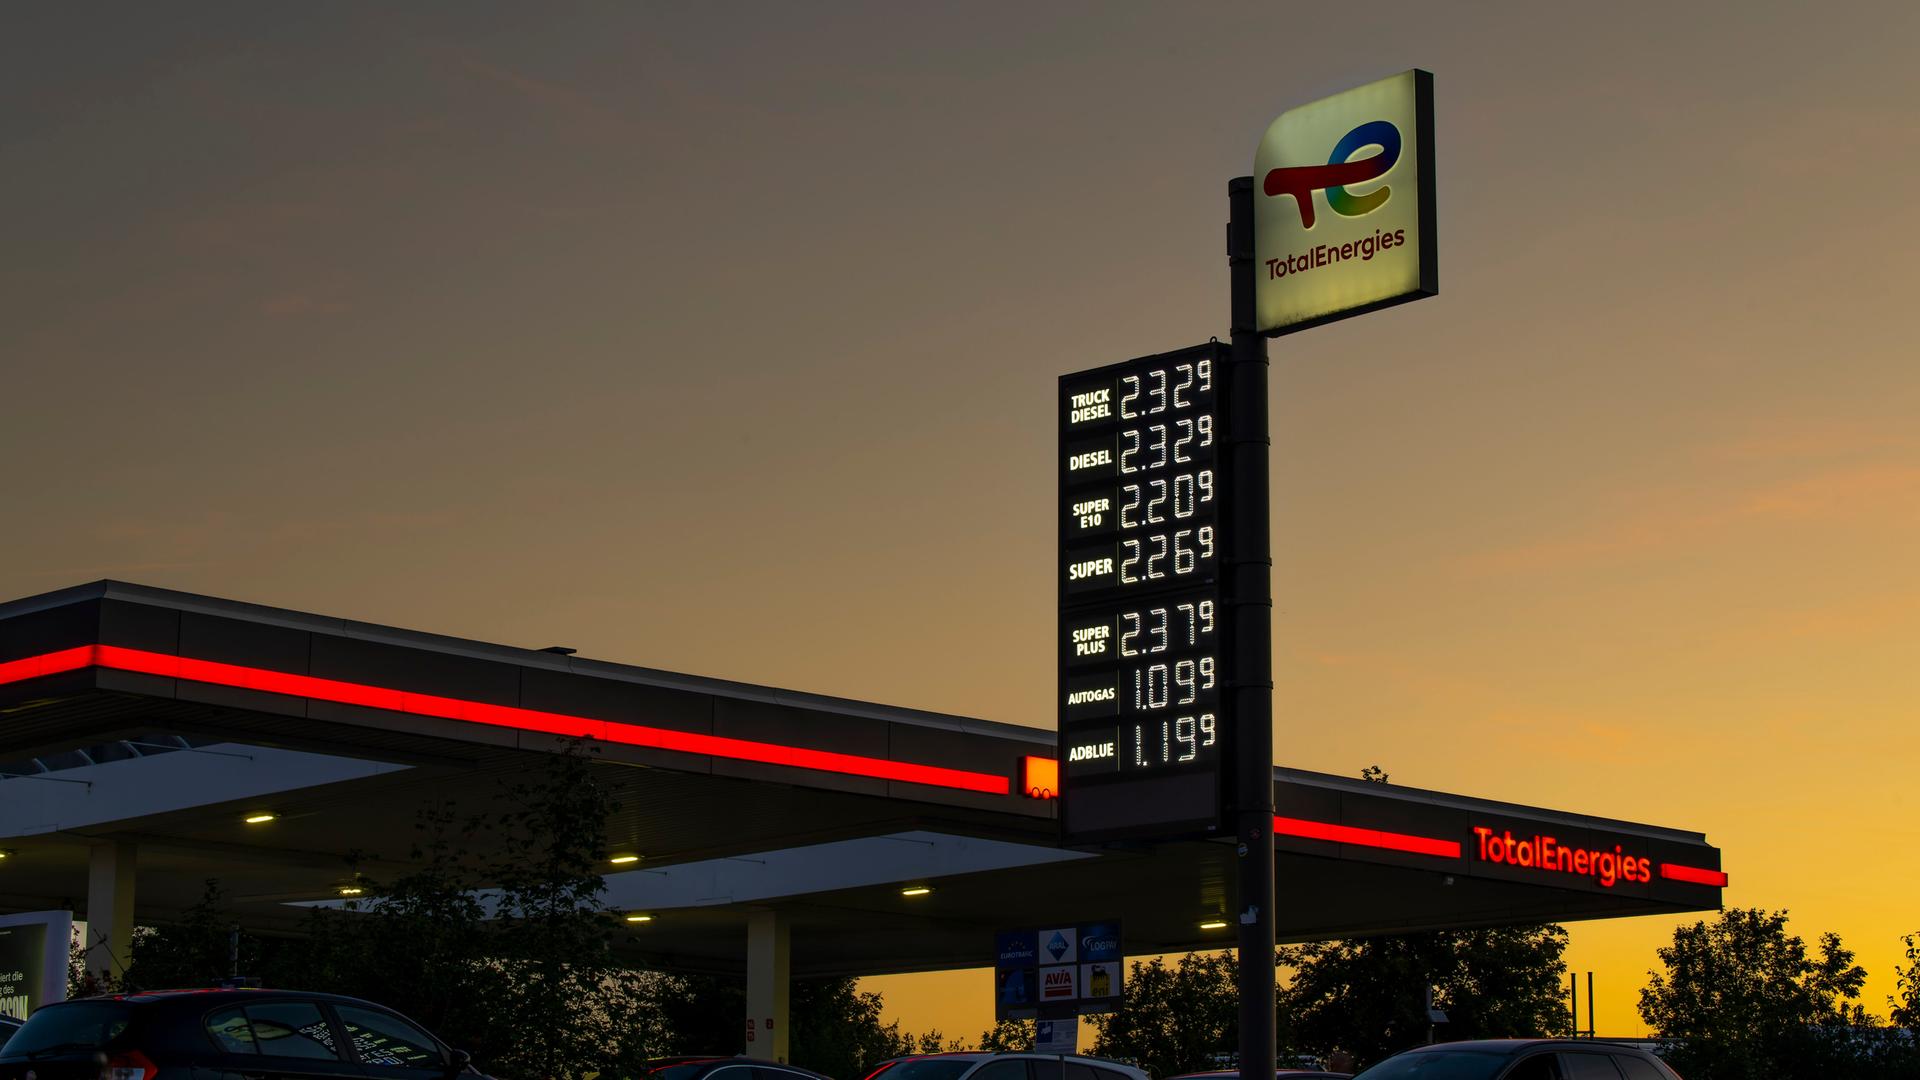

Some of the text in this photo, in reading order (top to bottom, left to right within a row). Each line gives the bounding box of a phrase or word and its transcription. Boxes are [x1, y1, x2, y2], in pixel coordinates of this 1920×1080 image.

[1266, 228, 1405, 280] TotalEnergies
[1071, 389, 1110, 409] TRUCK
[1072, 404, 1111, 423] DIESEL
[1070, 450, 1112, 470] DIESEL
[1073, 499, 1109, 517] SUPER
[1080, 512, 1101, 528] E10
[1070, 558, 1112, 580] SUPER
[1073, 626, 1109, 643] SUPER
[1077, 642, 1105, 656] PLUS
[1068, 688, 1115, 704] AUTOGAS
[1069, 743, 1114, 761] ADBLUE
[1473, 826, 1651, 887] TotalEnergies
[12, 972, 23, 981] die
[1045, 969, 1072, 985] AVIA
